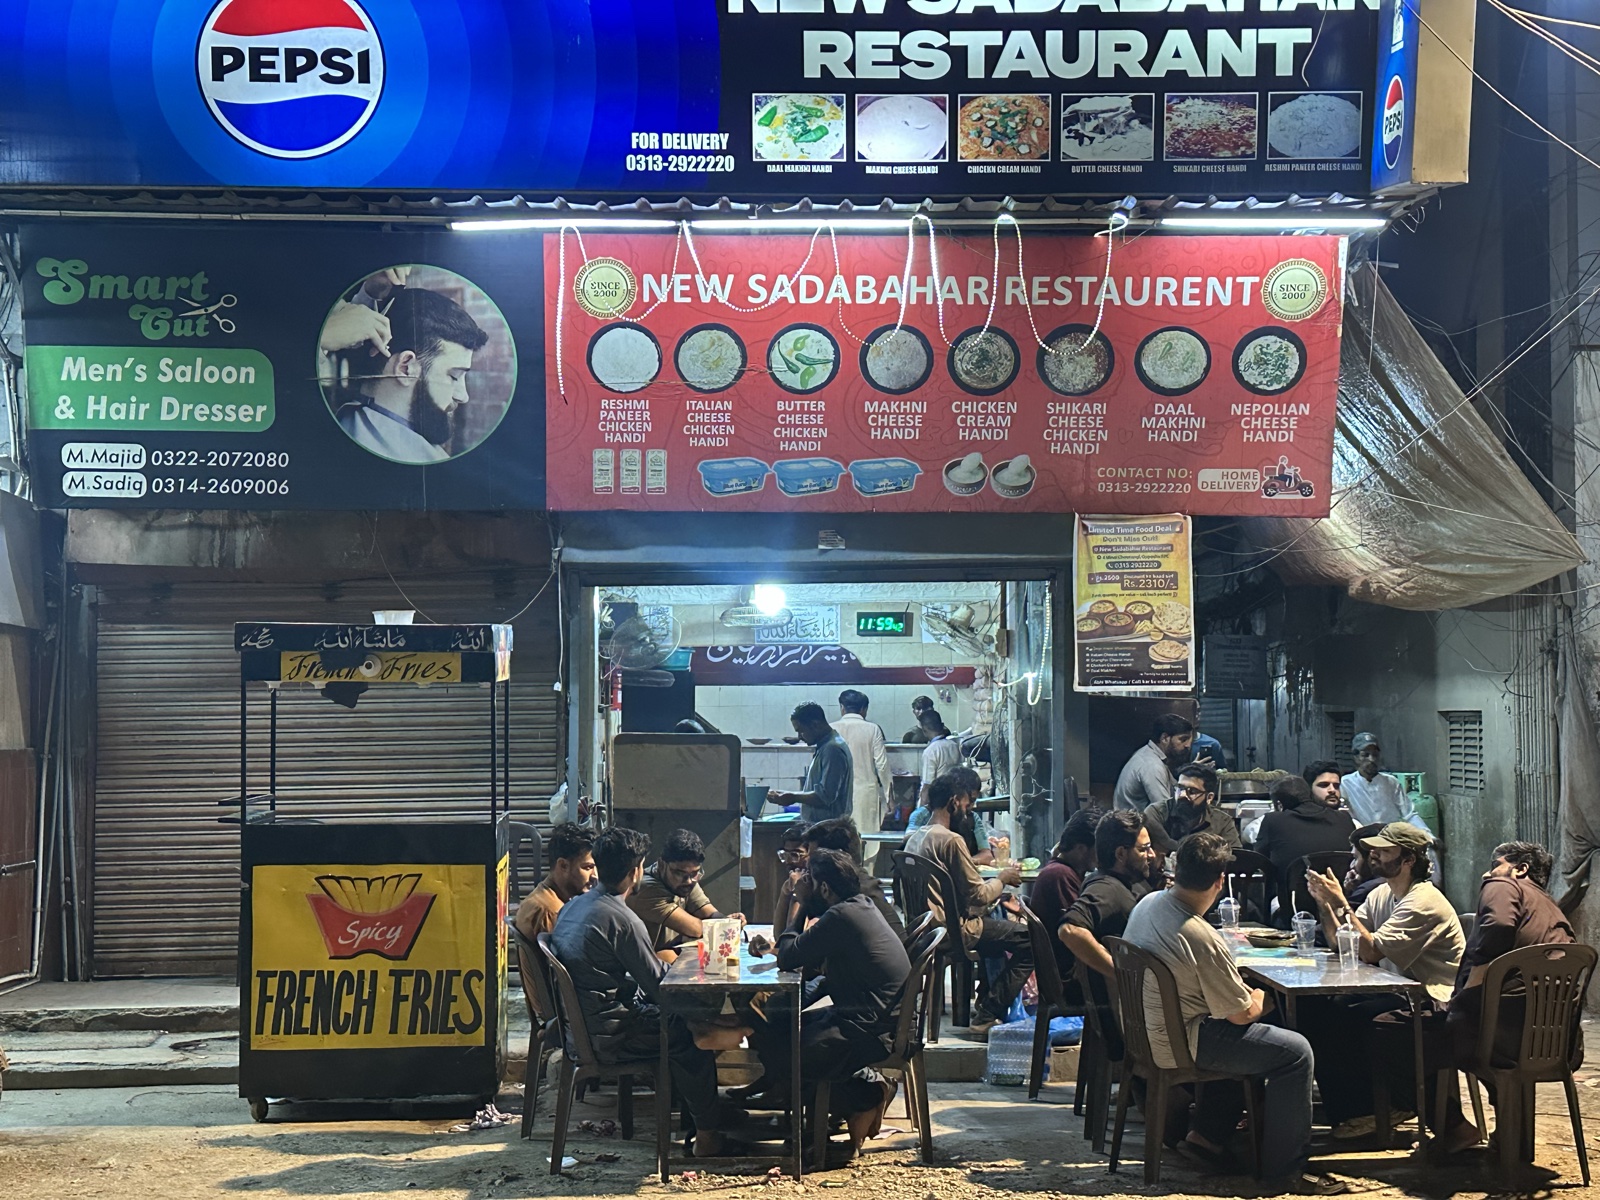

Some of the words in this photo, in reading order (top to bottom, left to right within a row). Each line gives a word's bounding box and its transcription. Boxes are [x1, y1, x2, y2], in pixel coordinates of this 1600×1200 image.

[803, 28, 1313, 79] RESTAURANT
[211, 46, 371, 84] PEPSI
[1384, 109, 1403, 135] PEPSI
[631, 132, 660, 149] FOR
[662, 133, 729, 150] DELIVERY
[626, 154, 735, 172] 0313-2922220
[997, 165, 1020, 173] CREAM
[1021, 165, 1041, 173] HANDI
[1071, 165, 1096, 173] BUTTER
[1097, 165, 1121, 173] CHEESE
[1122, 165, 1143, 173] HANDI
[1201, 165, 1226, 173] CHEESE
[1265, 163, 1290, 171] RESHMI
[1342, 163, 1362, 171] HANDI
[893, 166, 917, 174] CHEESE
[36, 257, 210, 305] Smart
[590, 281, 621, 290] SINCE
[642, 273, 734, 303] NEW
[747, 273, 989, 305] SADABAHAR
[1005, 275, 1260, 306] RESTAURENT
[1279, 283, 1310, 292] SINCE
[128, 304, 210, 340] Cut
[157, 357, 255, 384] Saloon
[54, 395, 76, 420] &
[86, 395, 150, 421] Hair
[160, 396, 267, 422] Dresser
[601, 400, 649, 410] RESHMI
[686, 400, 732, 411] ITALIAN
[777, 401, 826, 411] BUTTER
[864, 401, 927, 413] MAKHNI
[951, 401, 1017, 413] CHICKEN
[1046, 402, 1107, 414] SHIKARI
[1154, 403, 1195, 415] DAAL
[1230, 403, 1310, 415] NEPOLIAN
[600, 411, 651, 421] PANEER
[687, 412, 731, 423] CHEESE
[777, 414, 824, 425] CHEESE
[868, 414, 923, 427] CHEESE
[957, 415, 1011, 427] CREAM
[1049, 416, 1104, 428] CHEESE
[598, 421, 652, 432] CHICKEN
[1141, 417, 1206, 429] MAKHNI
[1240, 417, 1298, 429] CHEESE
[683, 425, 735, 435] CHICKEN
[773, 427, 828, 438] CHICKEN
[870, 428, 920, 440] HANDI
[959, 429, 1009, 441] HANDI
[1043, 429, 1108, 441] CHICKEN
[1148, 430, 1198, 442] HANDI
[604, 433, 646, 443] HANDI
[689, 437, 728, 447] HANDI
[1243, 430, 1294, 443] HANDI
[780, 441, 821, 451] HANDI
[1050, 442, 1100, 455] HANDI
[66, 448, 143, 467] M.Majid
[151, 450, 289, 468] 0322-2072080
[1097, 467, 1163, 478] CONTACT
[1167, 468, 1193, 479] NO:
[1221, 471, 1259, 481] HOME
[67, 475, 143, 494] M.Sadiq
[151, 478, 289, 494] 0314-2609006
[1098, 482, 1191, 494] 0313-2922220
[1201, 481, 1259, 490] DELIVERY
[1089, 526, 1115, 534] Limited
[1116, 526, 1134, 534] Time
[1136, 525, 1153, 533] Food
[1155, 524, 1172, 532] Deal
[859, 617, 894, 631] 11:59
[338, 920, 403, 950] Spicy
[254, 969, 378, 1035] FRENCH
[388, 968, 485, 1035] FRIES
